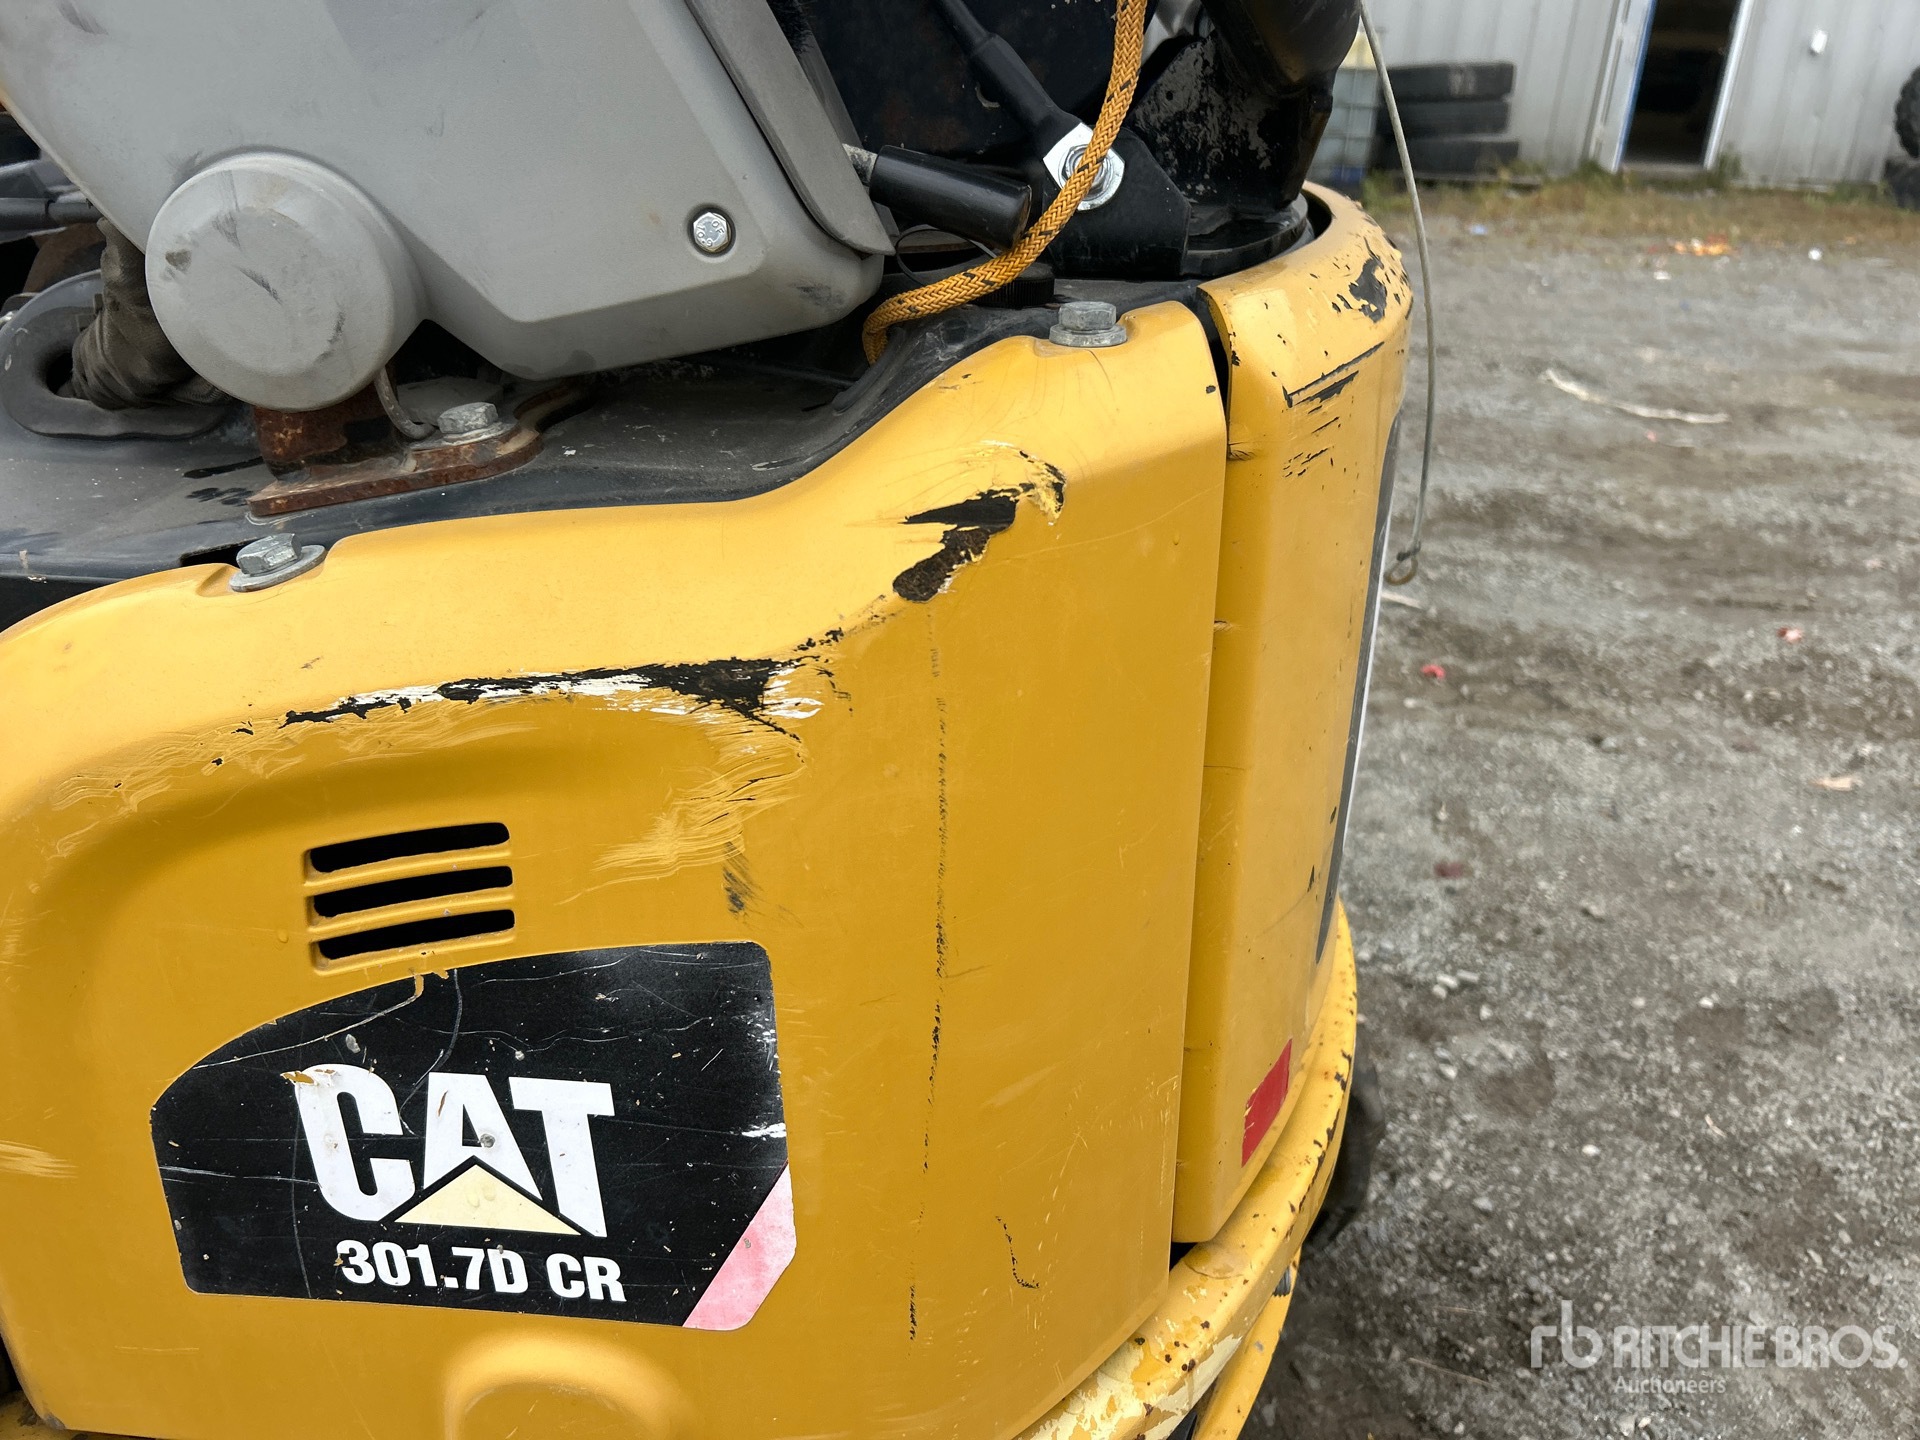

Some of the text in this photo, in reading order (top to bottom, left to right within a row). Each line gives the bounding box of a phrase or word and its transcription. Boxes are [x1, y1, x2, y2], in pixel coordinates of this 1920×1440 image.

[293, 1063, 616, 1238] CAT
[336, 1239, 627, 1302] 301.7D CR
